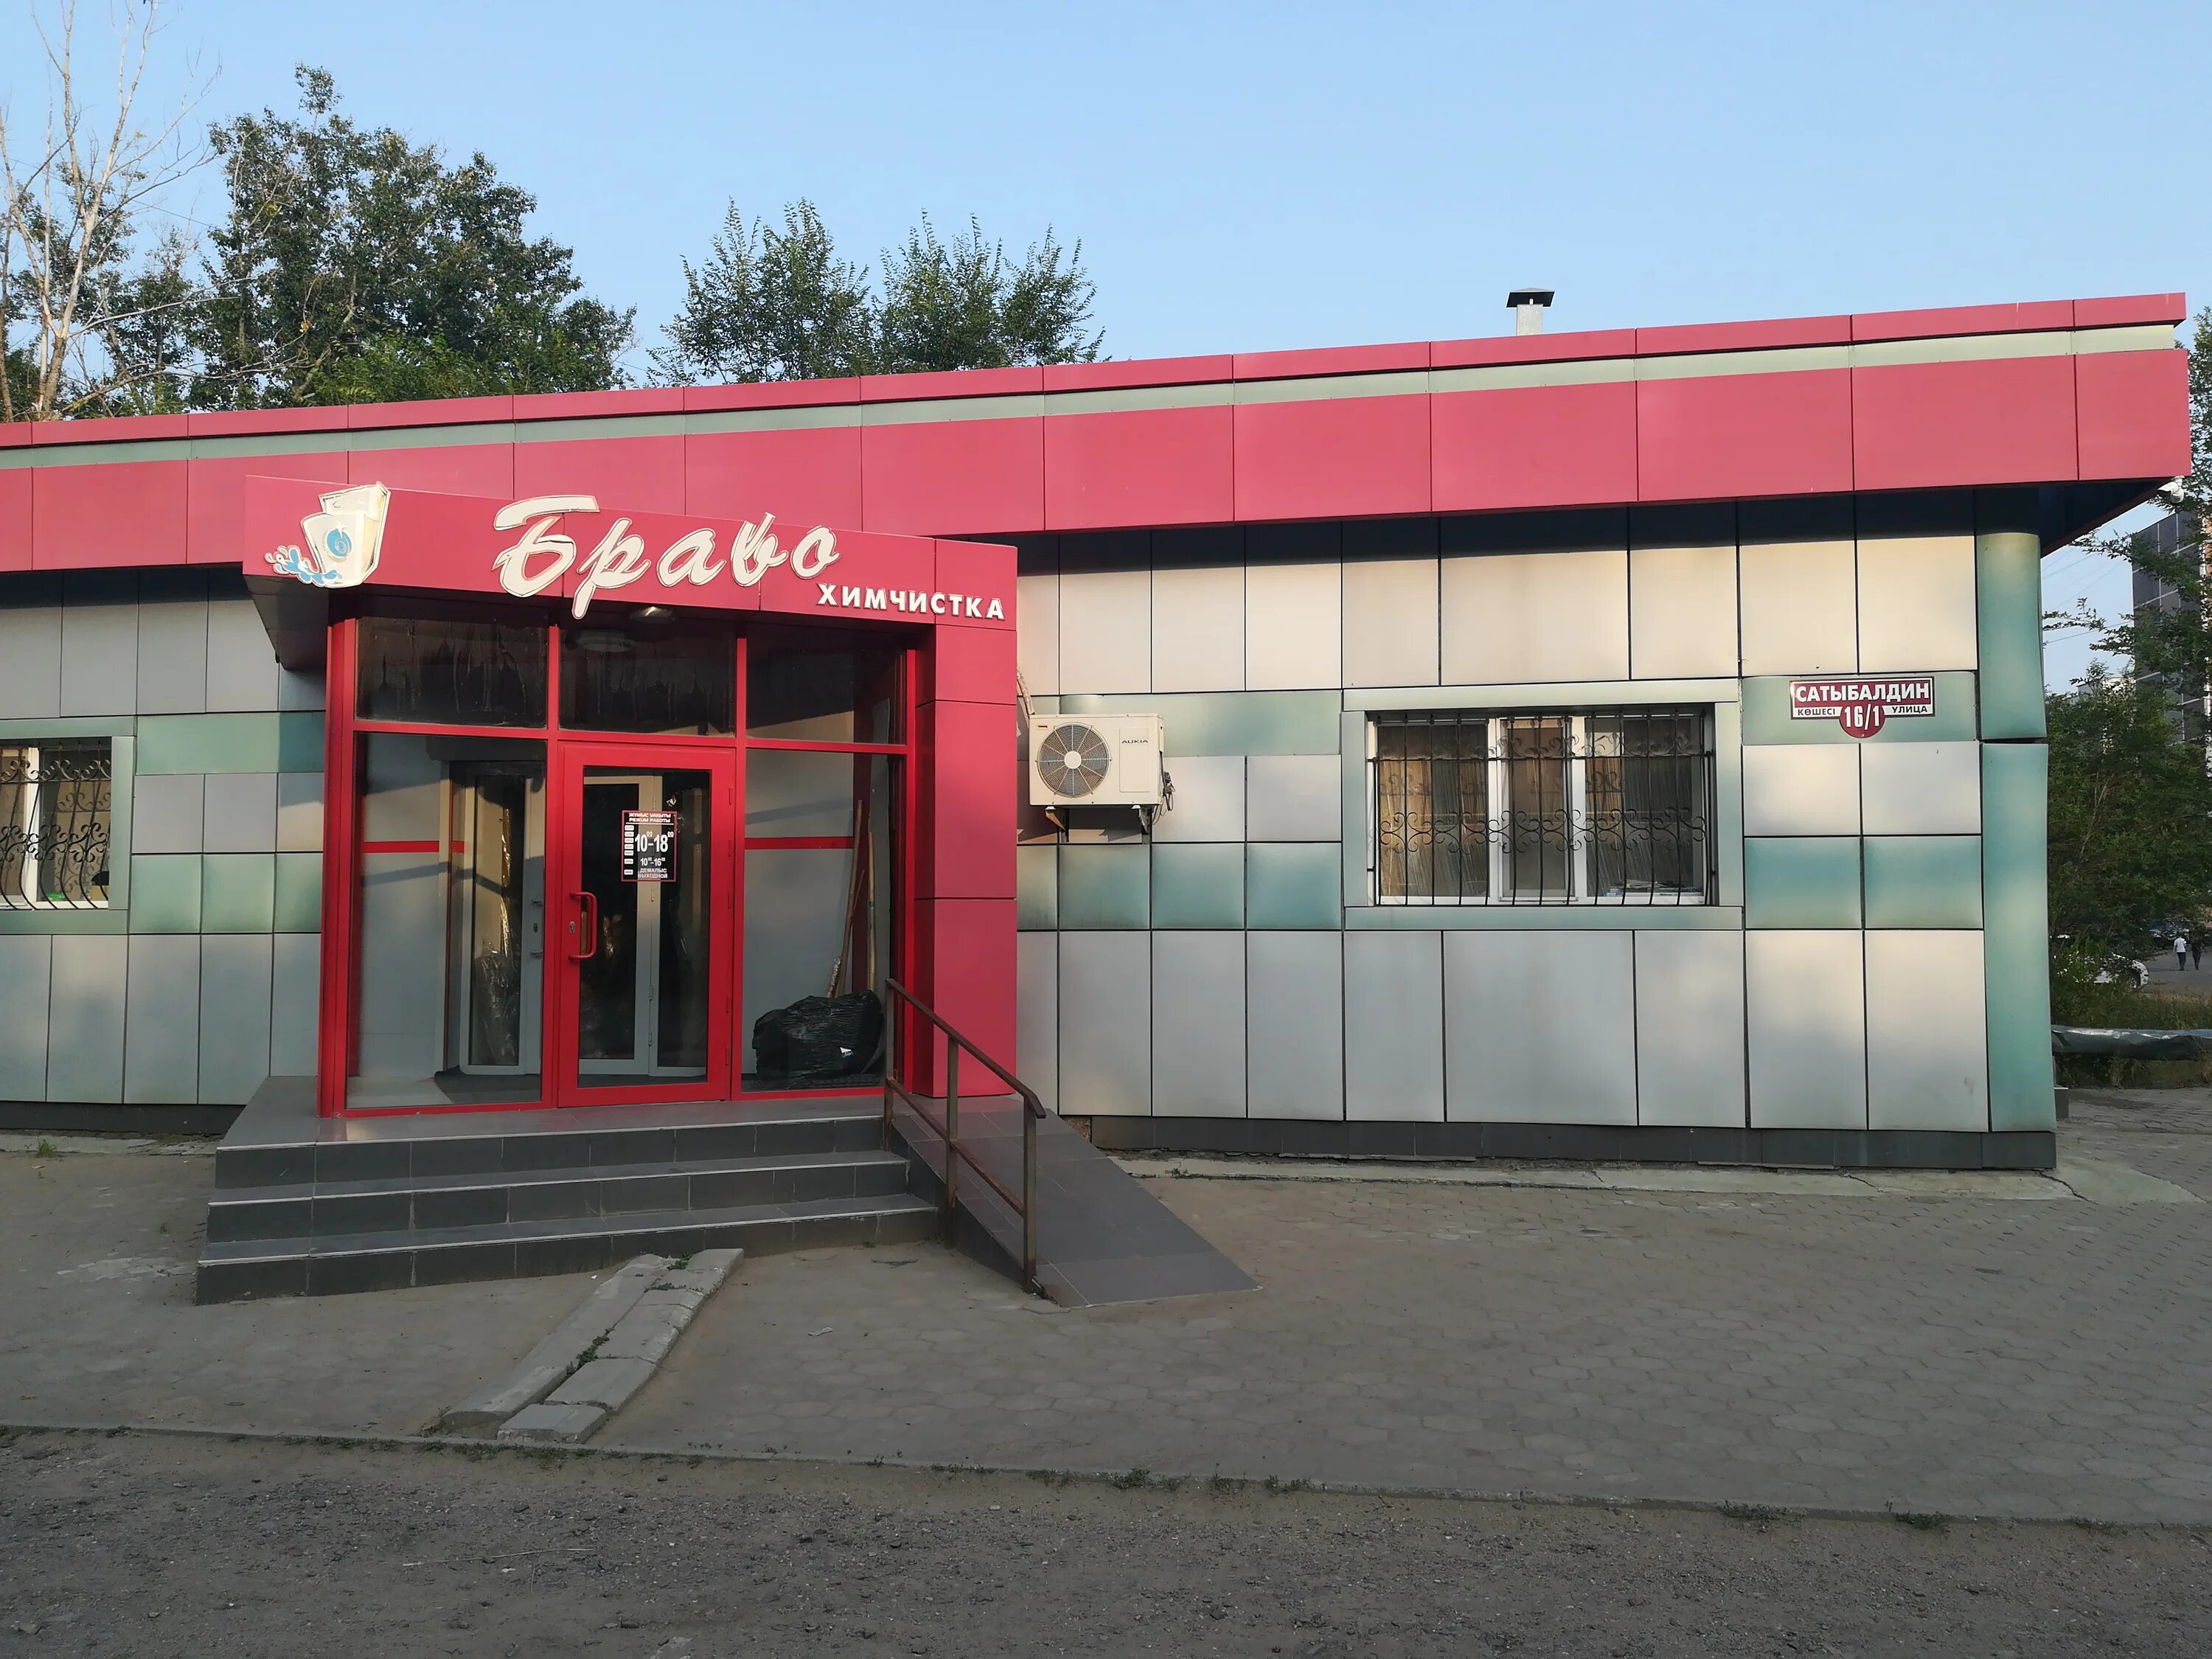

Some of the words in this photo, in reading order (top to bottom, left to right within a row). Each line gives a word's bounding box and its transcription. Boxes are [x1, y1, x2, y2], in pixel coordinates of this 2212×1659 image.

[493, 495, 840, 619] Браво
[816, 583, 1005, 620] ХИМЧИСТКА
[1795, 683, 1929, 702] САТЫБАЛДИН
[1844, 703, 1879, 730] 16/1
[1892, 706, 1927, 714] УЛИЦА
